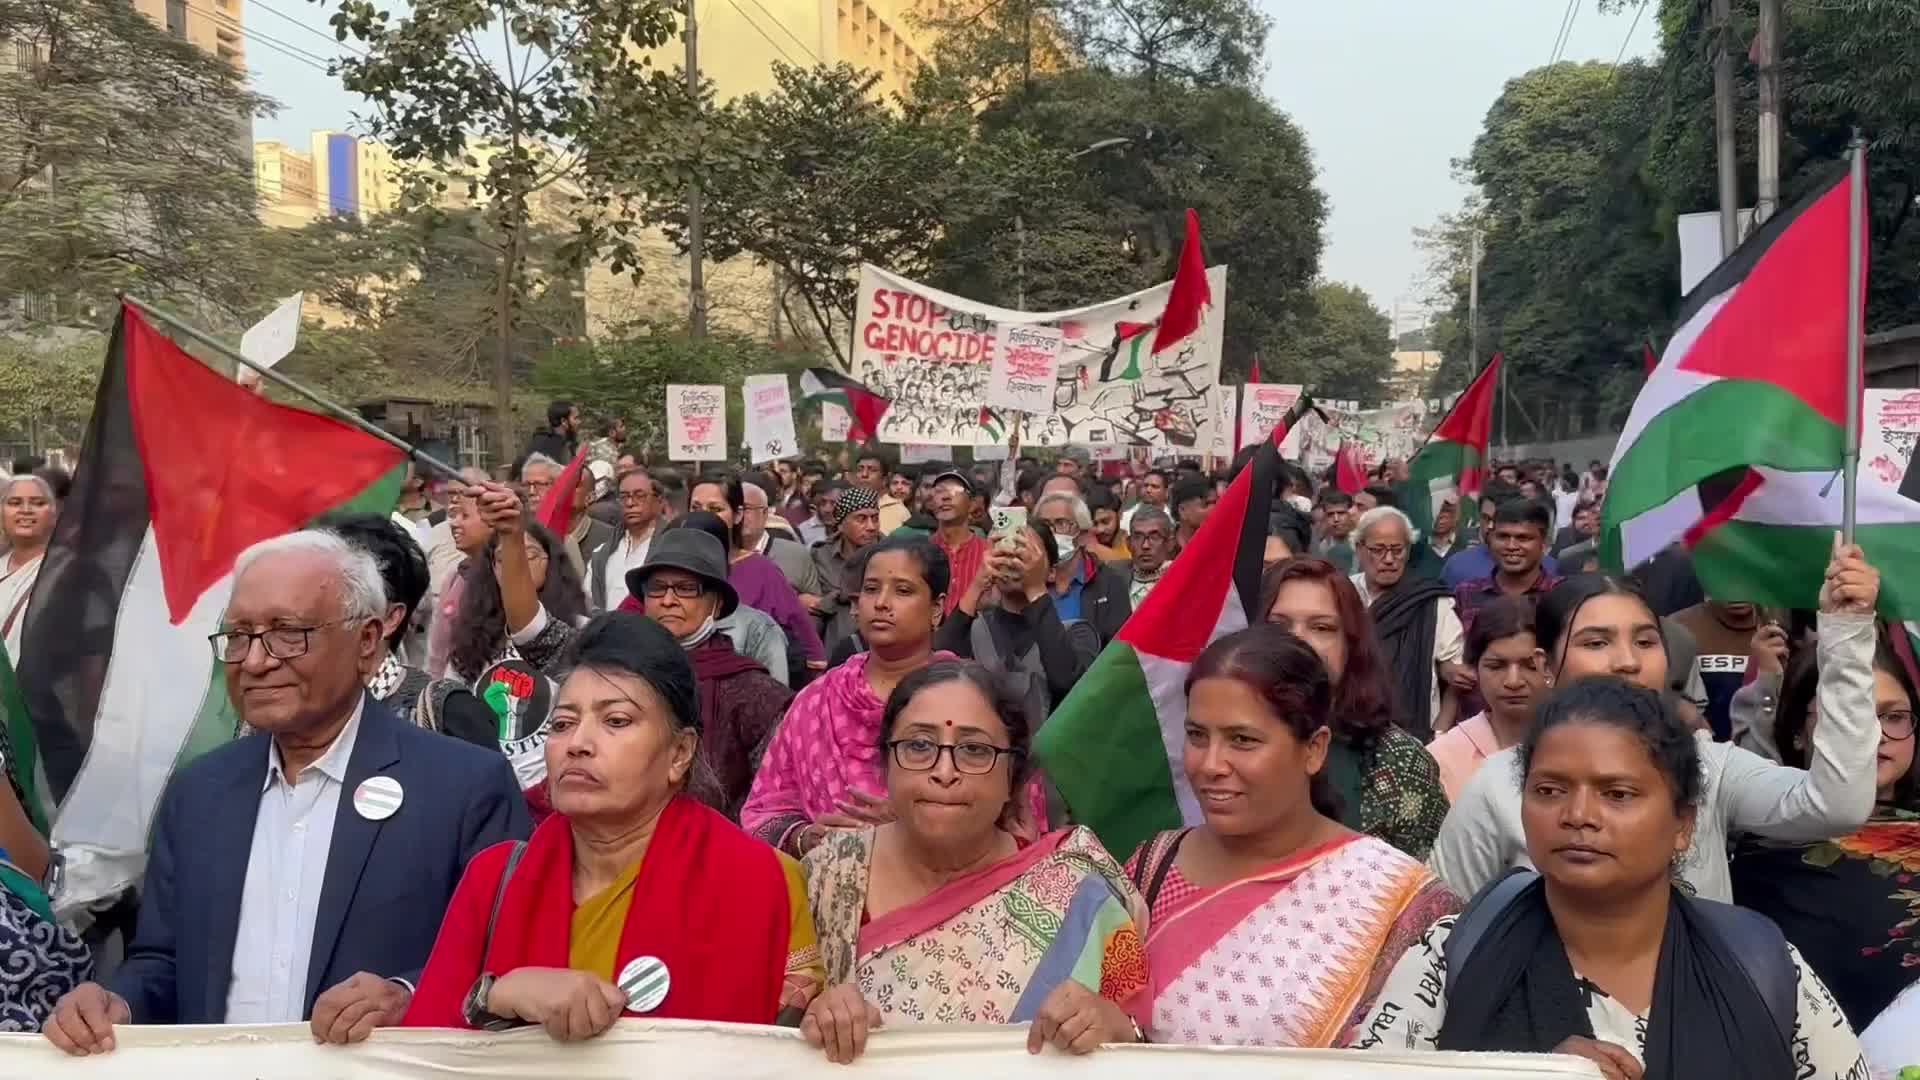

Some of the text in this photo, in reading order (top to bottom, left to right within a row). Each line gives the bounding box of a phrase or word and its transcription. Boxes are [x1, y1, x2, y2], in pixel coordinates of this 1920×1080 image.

[872, 288, 947, 329] STOP
[864, 321, 997, 362] GENOCIDE
[1700, 656, 1745, 669] ESP
